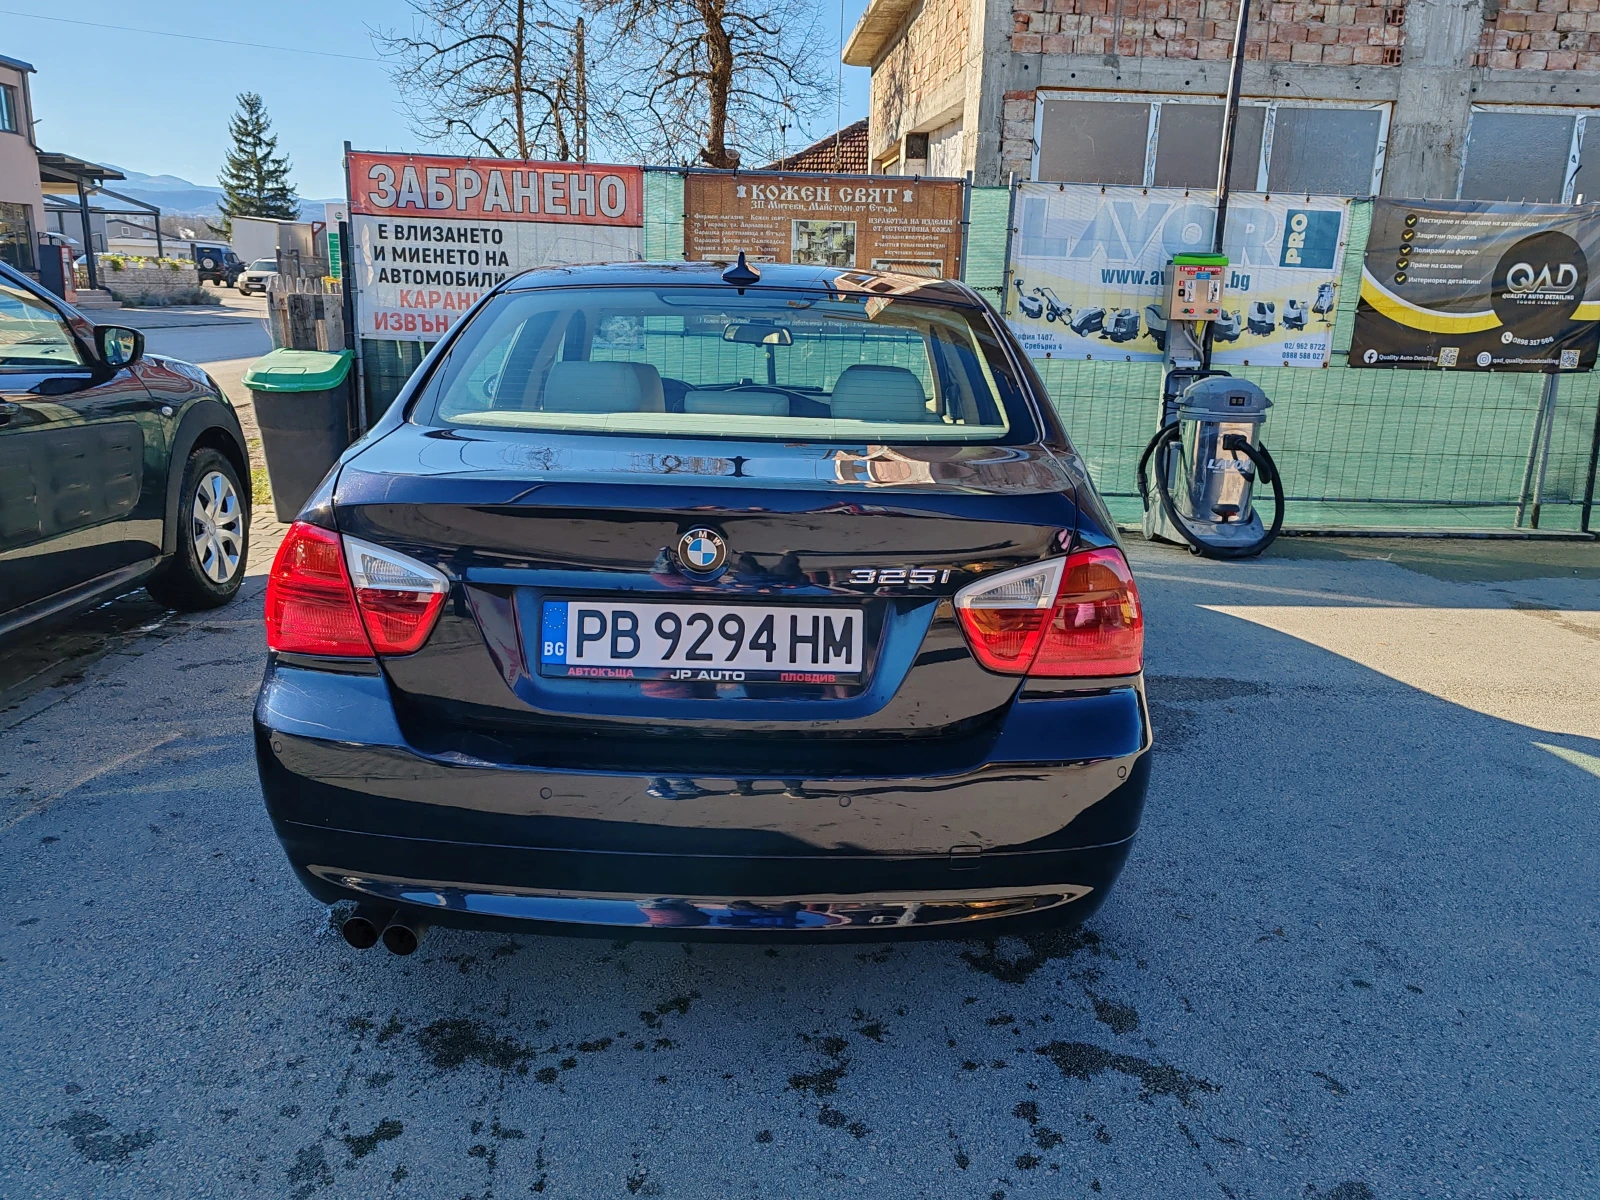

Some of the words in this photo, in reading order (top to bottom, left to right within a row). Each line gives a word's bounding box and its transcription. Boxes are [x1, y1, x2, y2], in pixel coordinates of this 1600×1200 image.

[368, 163, 626, 218] ЗАБРАНЕНО
[751, 185, 830, 201] КОЖЕН
[839, 187, 898, 203] СВЯТ
[378, 223, 388, 240] Е
[394, 225, 503, 245] ВЛИЗАНЕТО
[1285, 213, 1308, 265] PRO
[374, 245, 386, 261] И
[392, 246, 480, 266] МИЕНЕТО
[485, 249, 509, 267] НА
[1414, 246, 1446, 255] Полиране
[1410, 262, 1430, 270] Пране
[378, 267, 506, 288] АВТОМОБИЛИ
[1408, 276, 1447, 284] Интериорен
[1506, 262, 1578, 294] QAD
[374, 312, 448, 333] ИЗВЪН
[684, 530, 722, 547] BMW
[849, 569, 951, 584] 325i
[575, 609, 641, 660] PB
[654, 611, 776, 663] 9294
[788, 614, 853, 665] HM
[543, 641, 565, 656] BG
[568, 667, 634, 678] АВТОКЪЩА
[670, 670, 693, 681] JP
[698, 670, 745, 682] AUTO
[780, 672, 836, 683] ПЛОВДИВ
